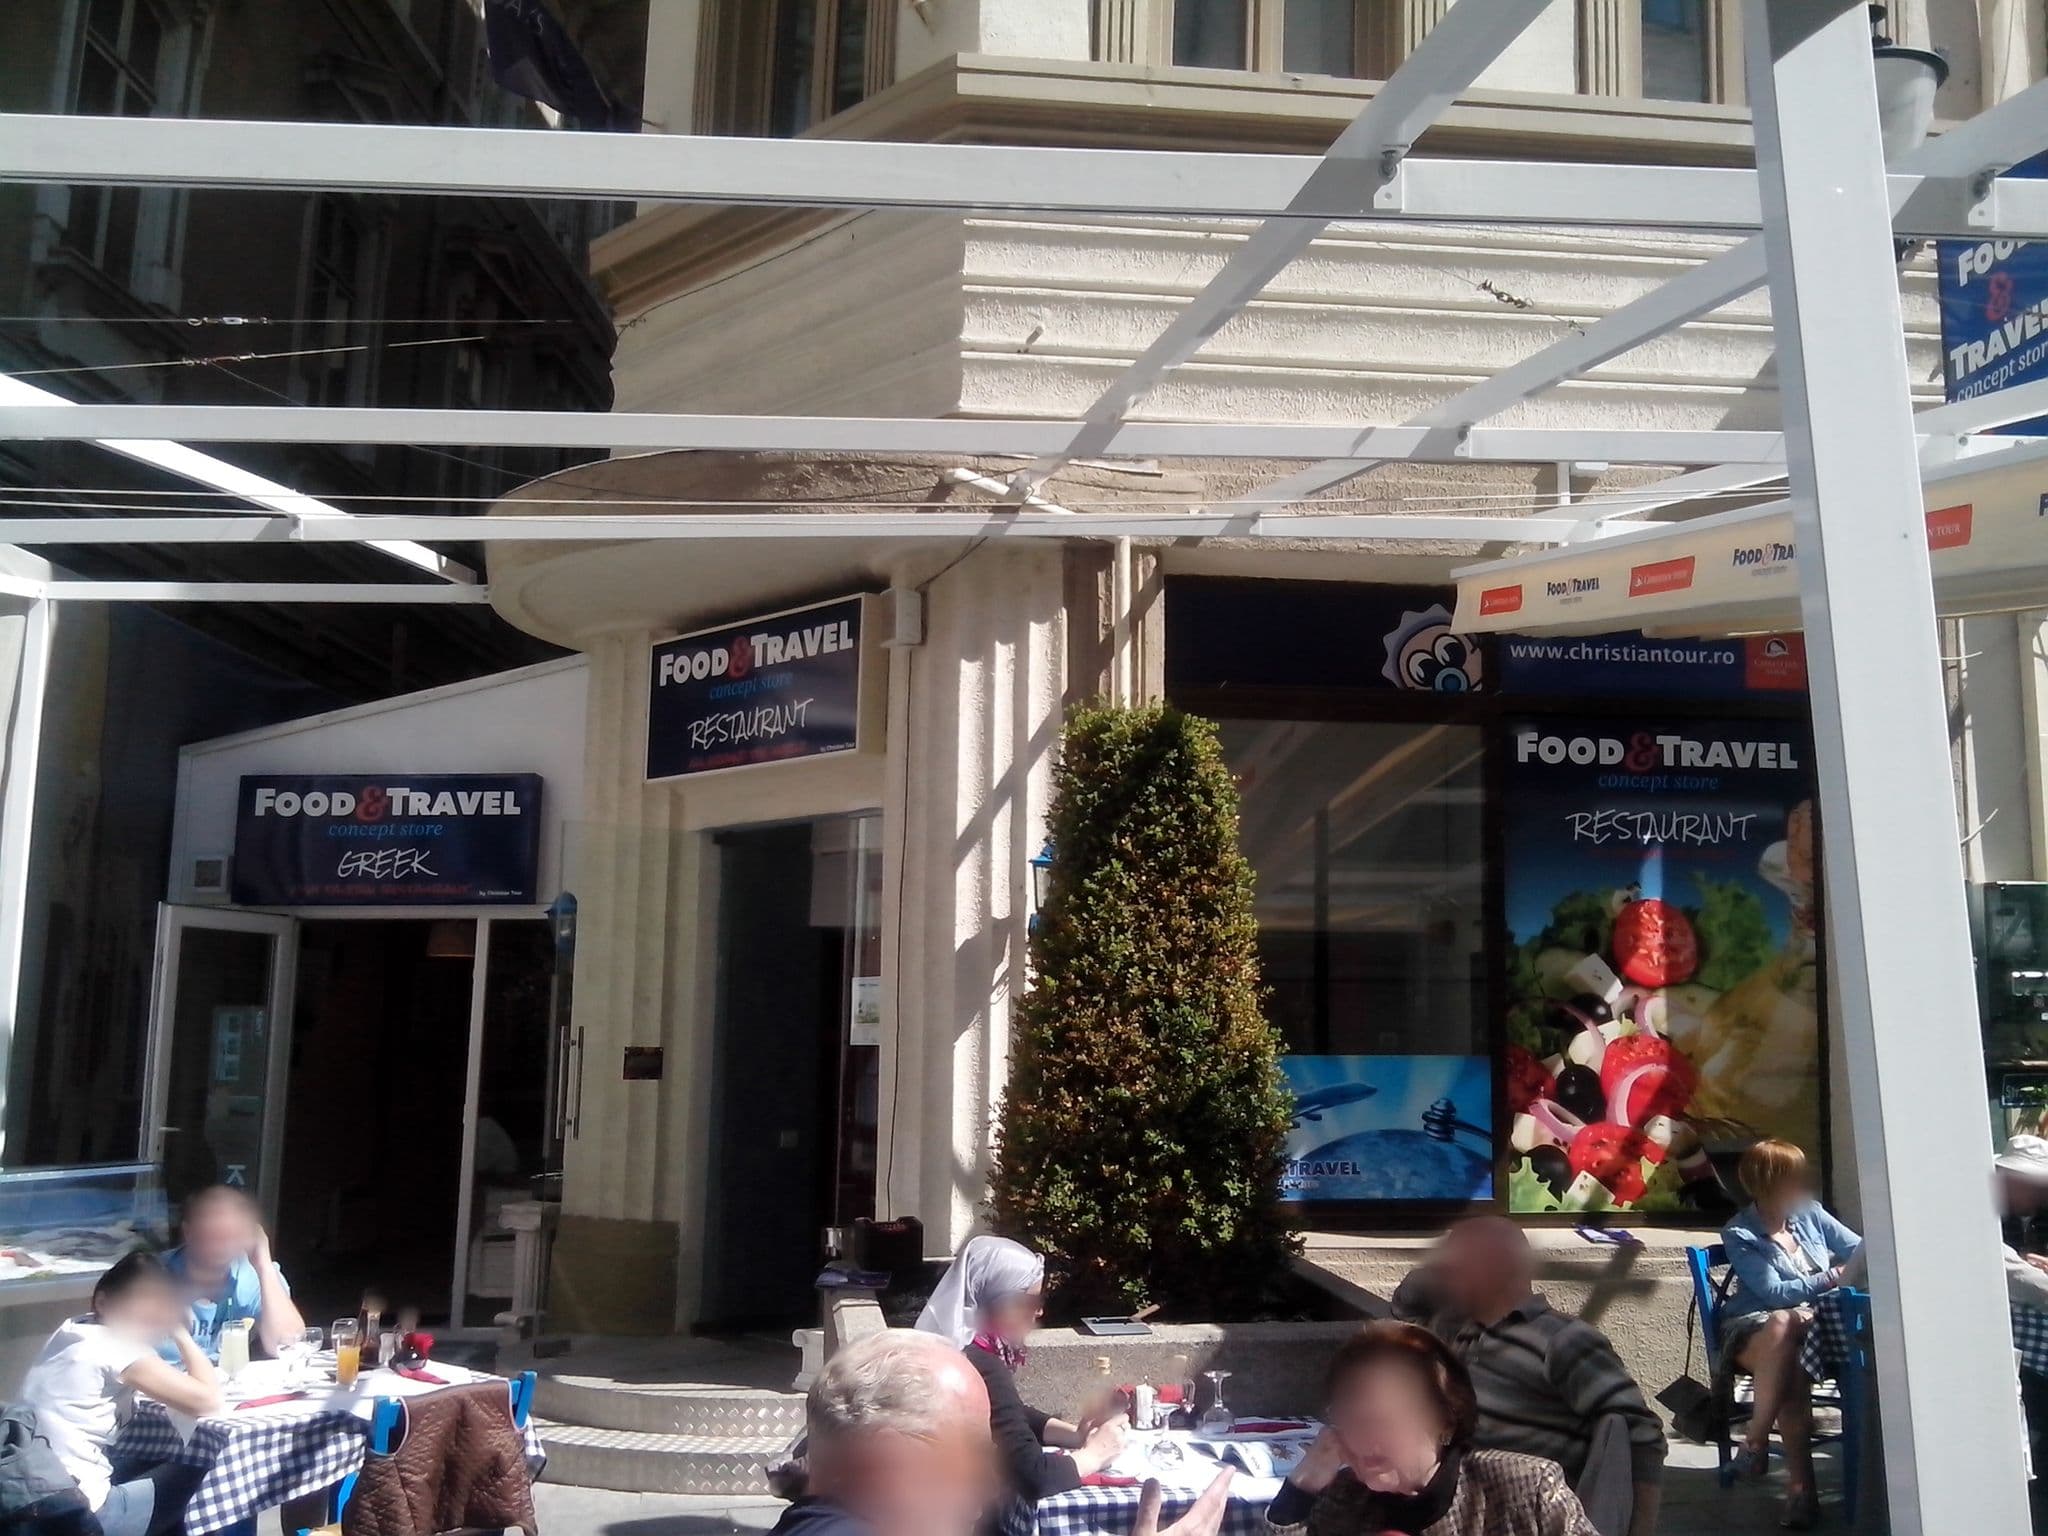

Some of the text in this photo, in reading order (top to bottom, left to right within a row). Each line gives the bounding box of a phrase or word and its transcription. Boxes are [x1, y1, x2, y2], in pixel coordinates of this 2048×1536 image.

[1958, 239, 2029, 287] FOO
[1957, 341, 2048, 402] concept stor
[1510, 642, 1735, 665] www.christiantour.ro
[709, 671, 794, 700] concept store
[687, 698, 814, 750] RESTAURANT
[1598, 774, 1720, 793] concept store
[328, 822, 444, 841] concept store
[1565, 809, 1757, 845] RESTAURANT
[337, 847, 439, 880] GREEK
